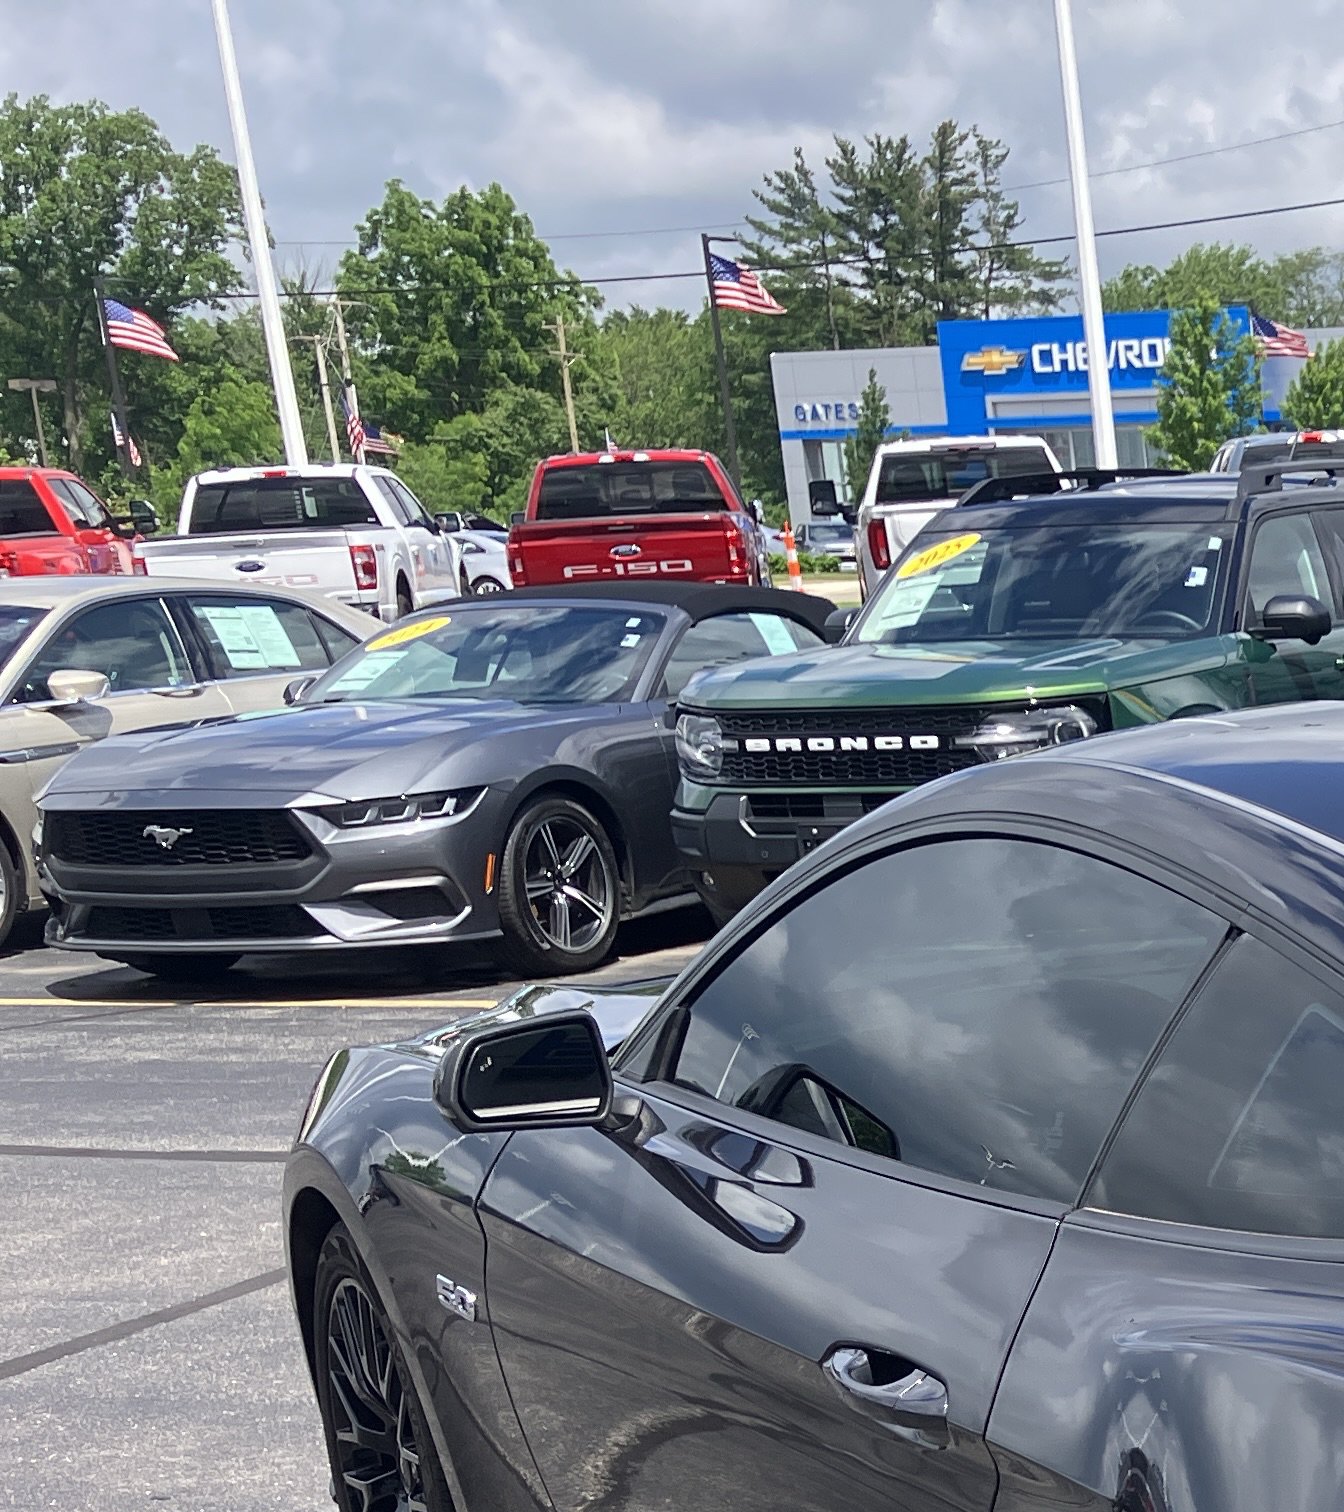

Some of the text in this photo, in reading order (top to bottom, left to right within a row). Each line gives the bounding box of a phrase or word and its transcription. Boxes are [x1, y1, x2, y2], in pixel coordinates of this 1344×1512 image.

[794, 403, 859, 422] GATES
[563, 560, 693, 578] F-150
[744, 735, 939, 752] BRONCO
